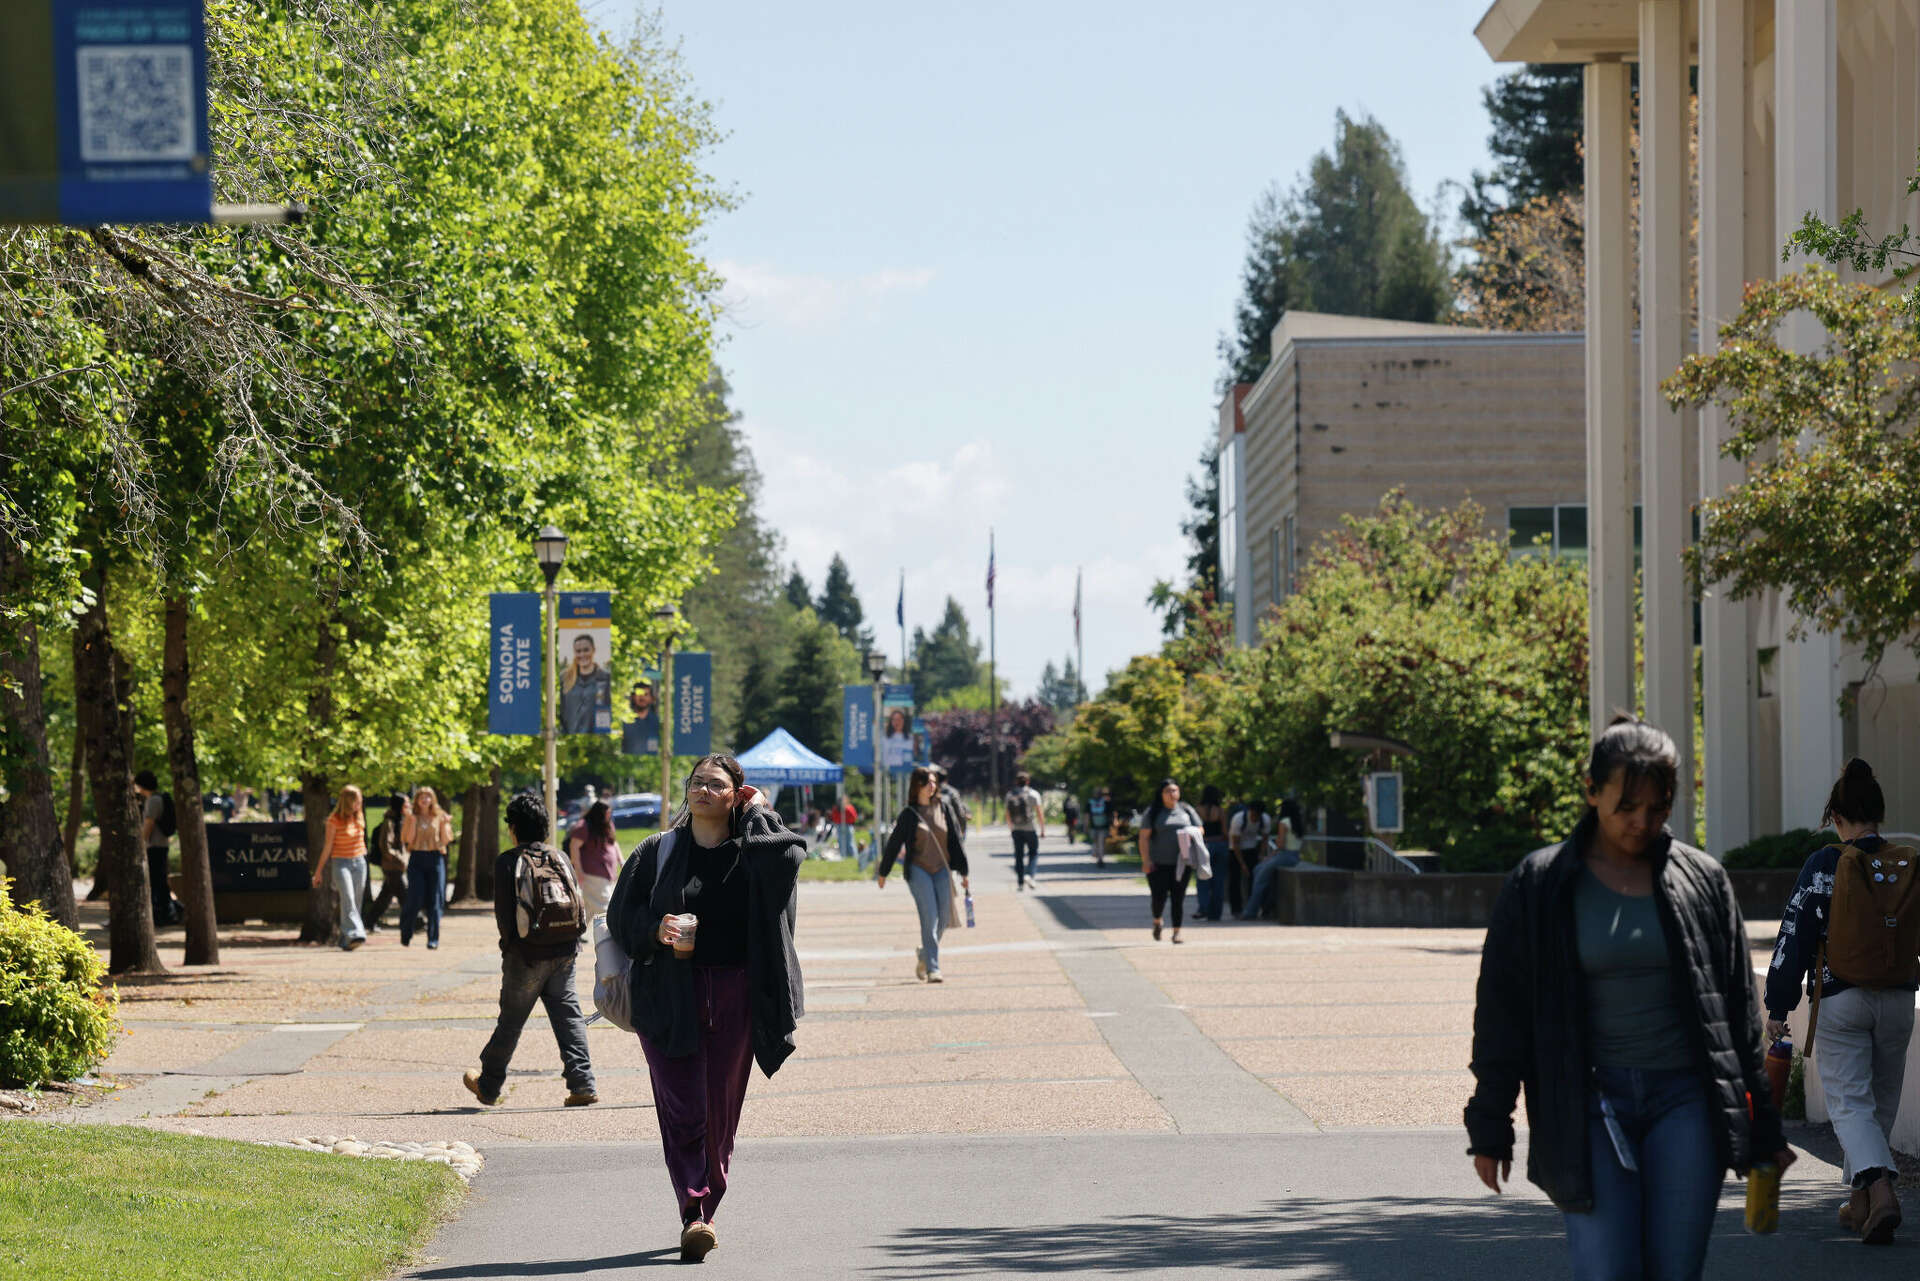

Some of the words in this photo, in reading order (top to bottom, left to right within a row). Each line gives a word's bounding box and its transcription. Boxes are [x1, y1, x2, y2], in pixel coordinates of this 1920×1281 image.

[500, 624, 514, 705] SONOMA
[516, 638, 530, 689] STATE
[680, 675, 692, 734] SONOMA
[693, 685, 704, 723] STATE
[790, 769, 825, 781] STATE
[226, 848, 308, 863] SALAZAR
[256, 867, 278, 878] Hall
